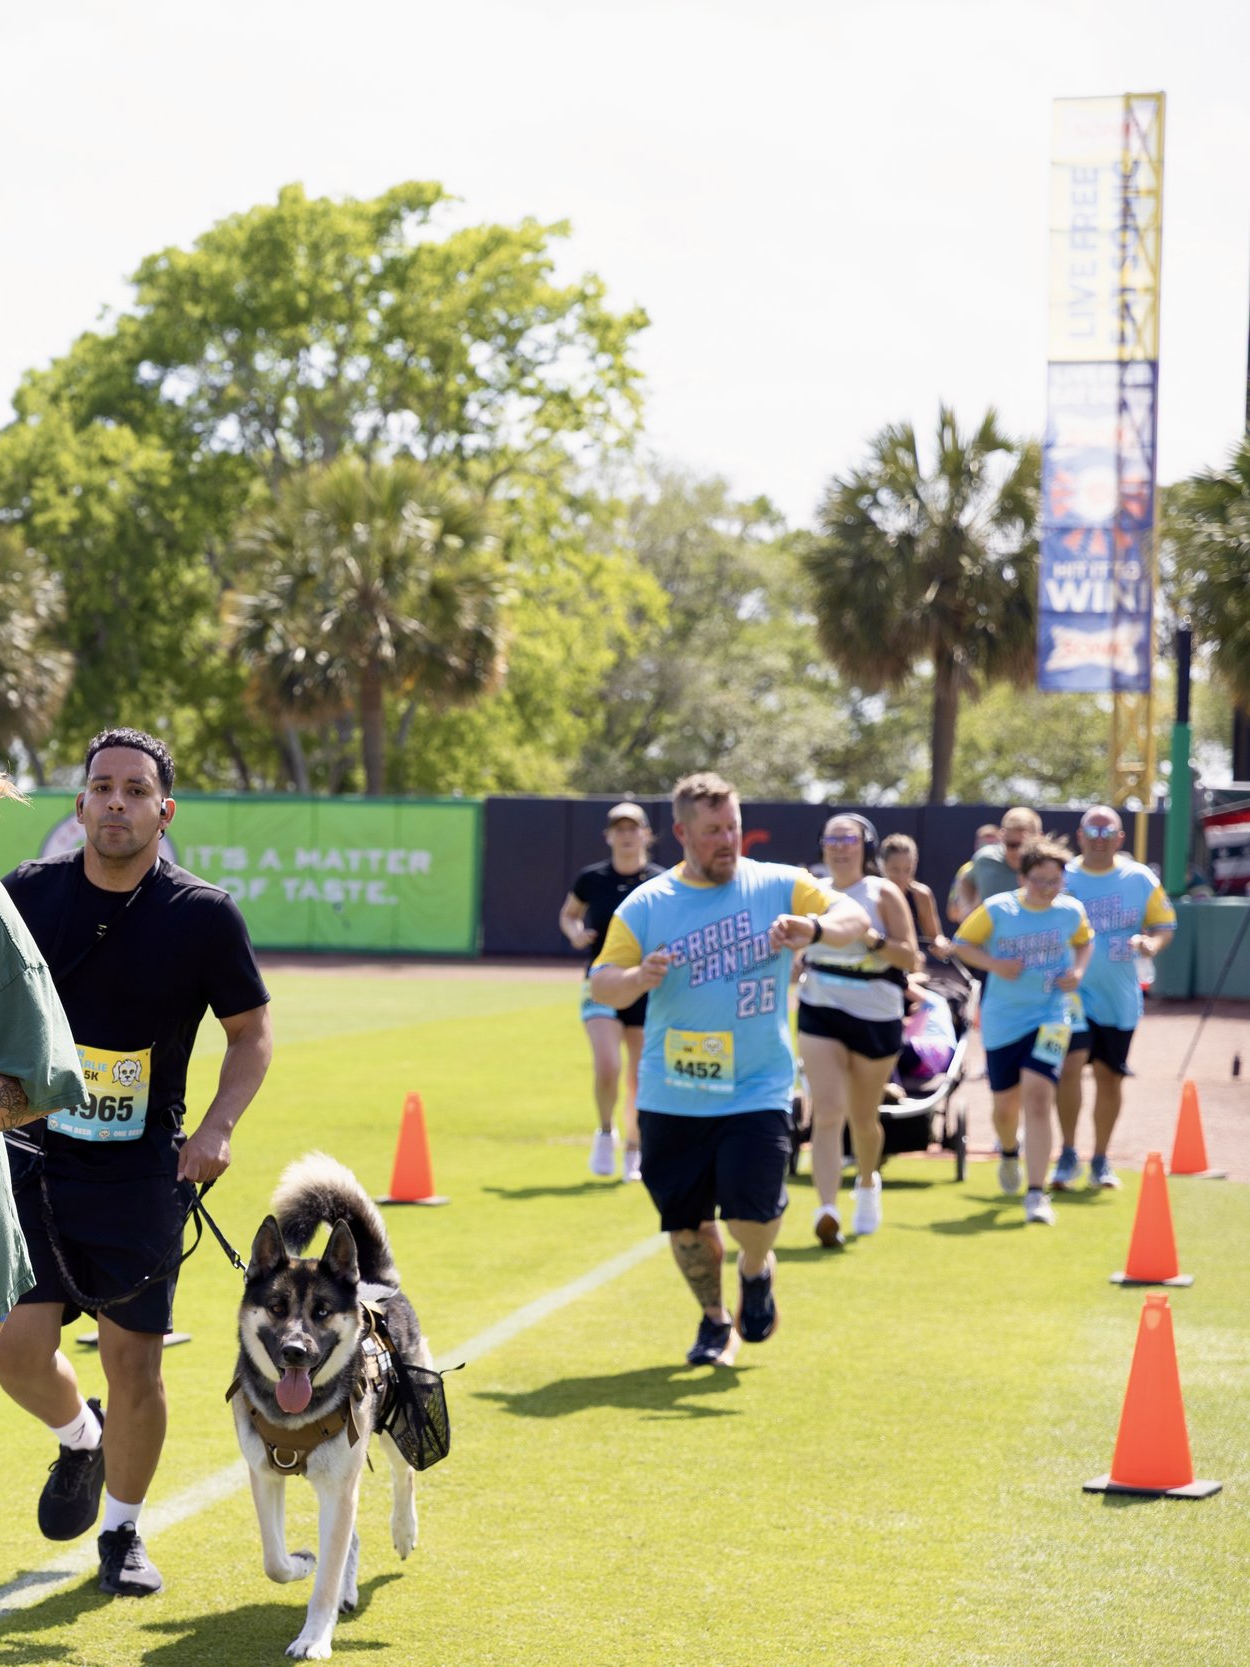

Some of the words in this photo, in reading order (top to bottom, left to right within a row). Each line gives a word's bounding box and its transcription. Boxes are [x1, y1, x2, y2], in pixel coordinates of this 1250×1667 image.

[259, 848, 282, 871] A
[295, 848, 432, 875] MATTER
[283, 879, 400, 906] TASTE.
[689, 929, 777, 988] SANTO
[736, 974, 778, 1020] 26
[84, 1070, 99, 1081] 5K
[673, 1059, 722, 1079] 4452
